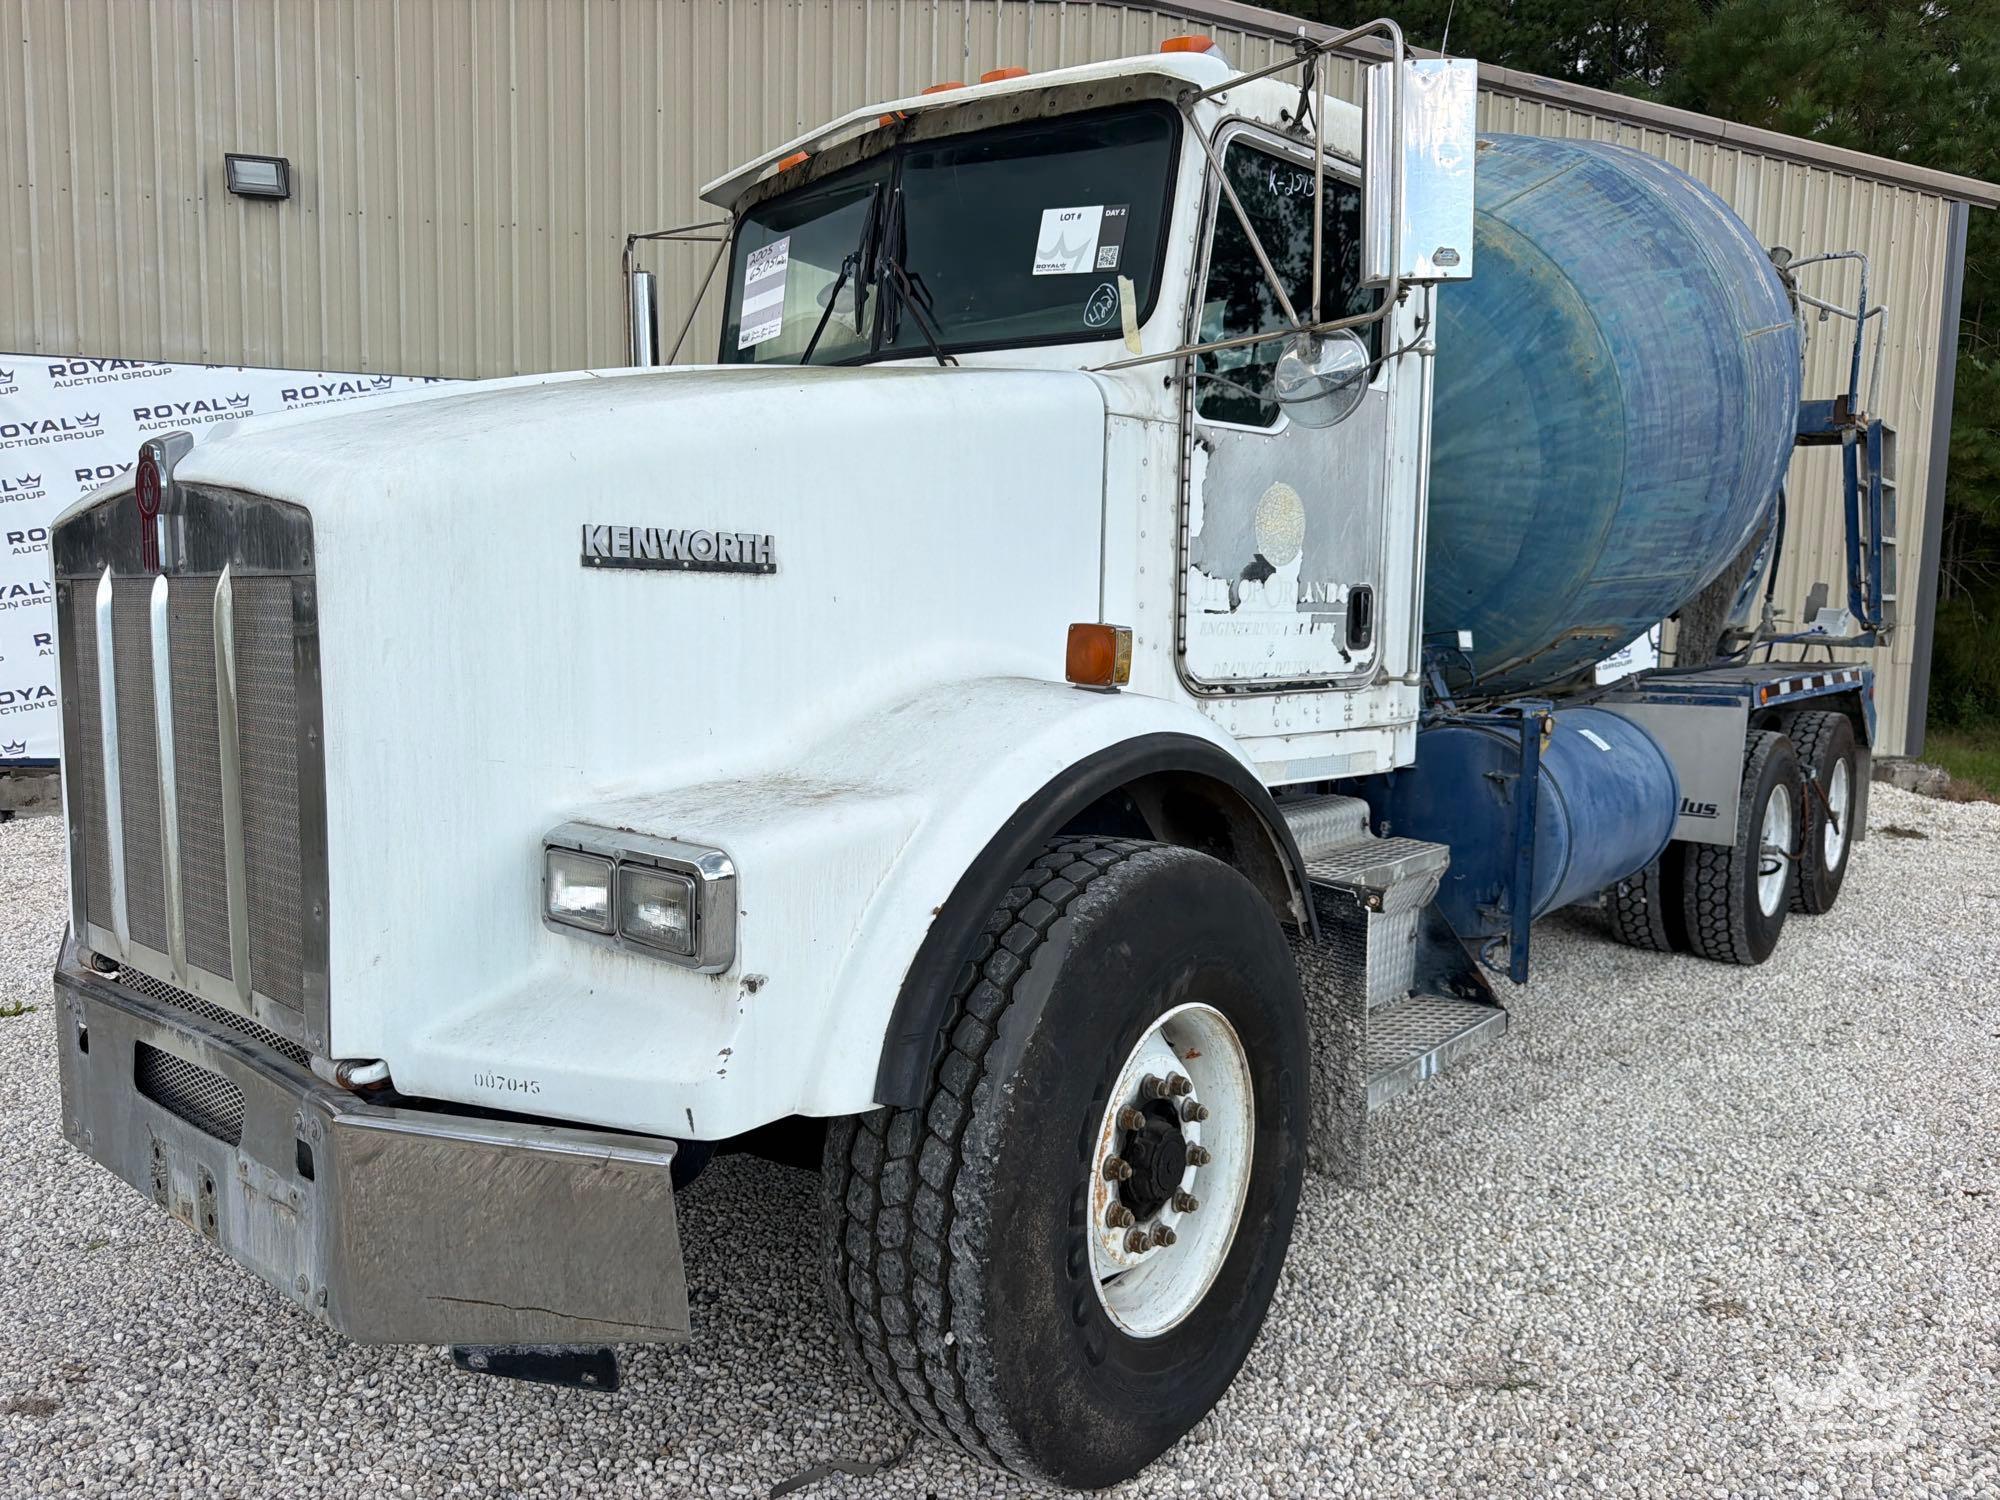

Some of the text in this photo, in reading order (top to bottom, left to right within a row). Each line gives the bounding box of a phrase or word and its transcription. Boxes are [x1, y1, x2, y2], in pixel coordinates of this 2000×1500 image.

[1060, 213, 1076, 222] LOT
[1105, 208, 1126, 217] DAY 2
[750, 244, 774, 266] 2005
[53, 367, 172, 389] AUCTION GROUP
[281, 380, 371, 402] ROYAL
[133, 398, 227, 421] ROYAL
[0, 417, 77, 438] OYAL
[138, 410, 254, 431] AUCTION GROUP
[53, 429, 105, 442] GROUP
[75, 462, 134, 482] ROY
[12, 543, 49, 556] AUCT
[580, 523, 776, 565] KENWORTH
[21, 596, 52, 607] GRO
[0, 685, 55, 705] OYA
[0, 701, 46, 715] CTION
[1680, 797, 1718, 816] lus
[474, 1073, 540, 1094] 007045
